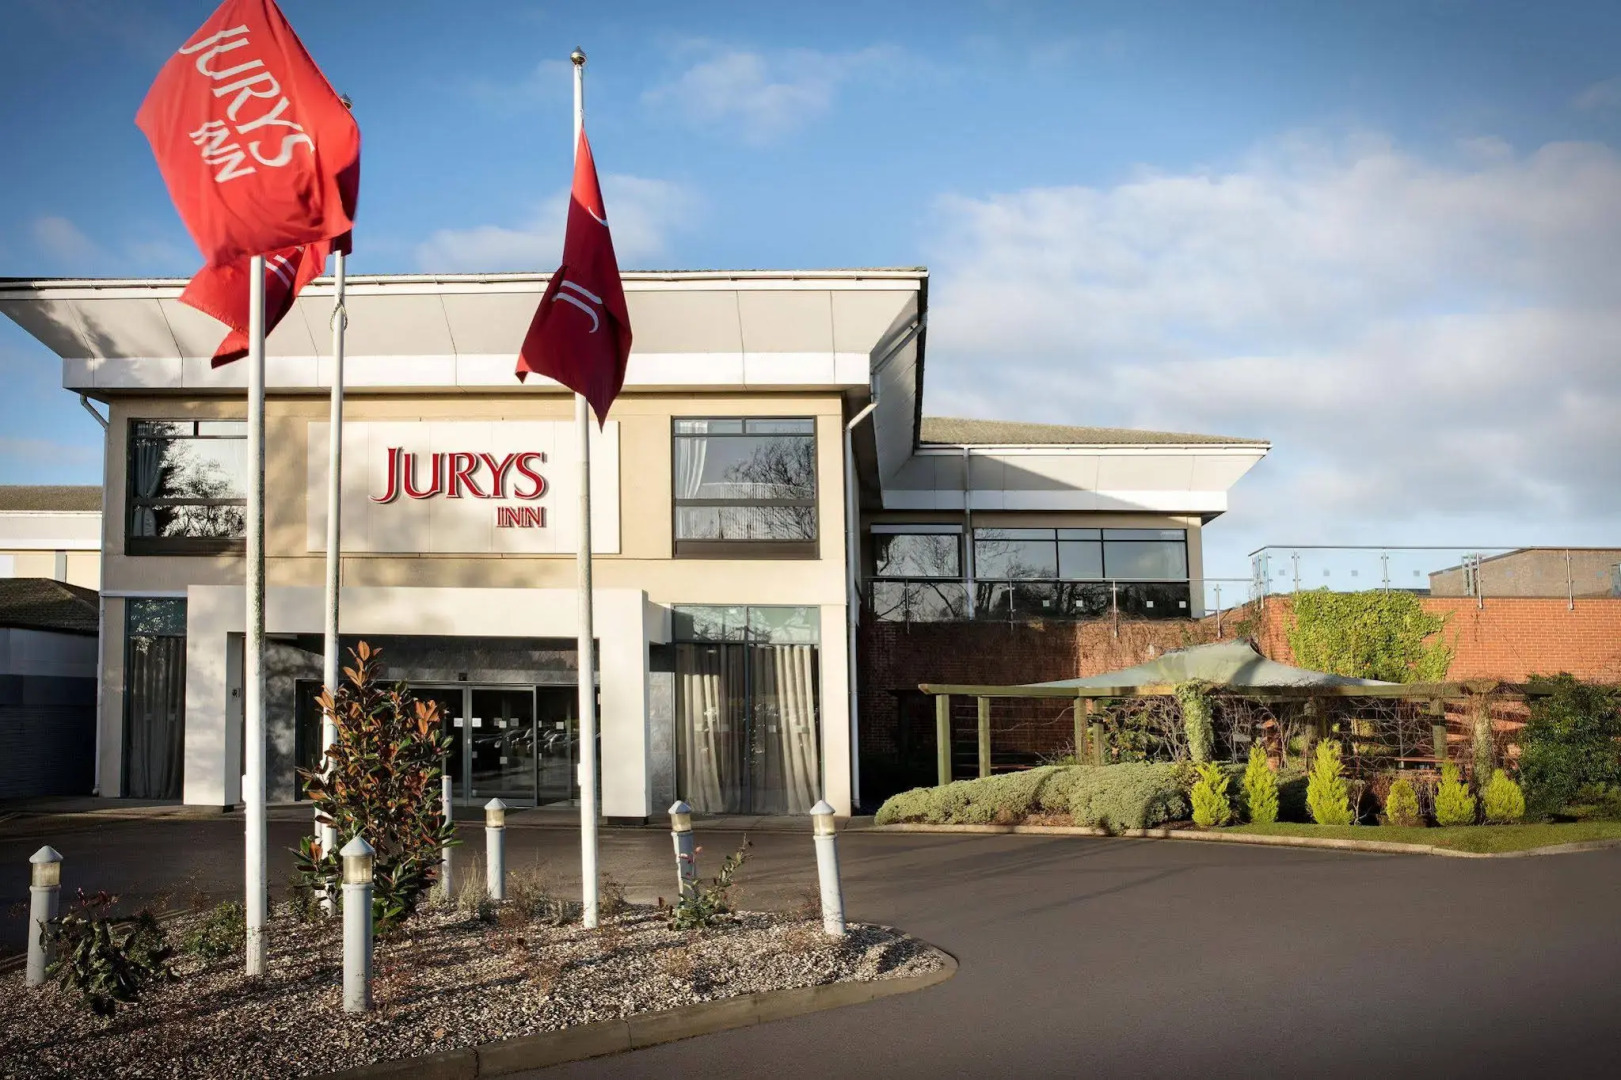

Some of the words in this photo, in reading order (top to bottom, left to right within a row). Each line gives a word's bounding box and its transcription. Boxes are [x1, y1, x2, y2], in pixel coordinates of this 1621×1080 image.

[178, 24, 315, 166] JURYS
[189, 119, 256, 184] INN
[369, 446, 547, 503] JURYS
[496, 506, 547, 528] INN
